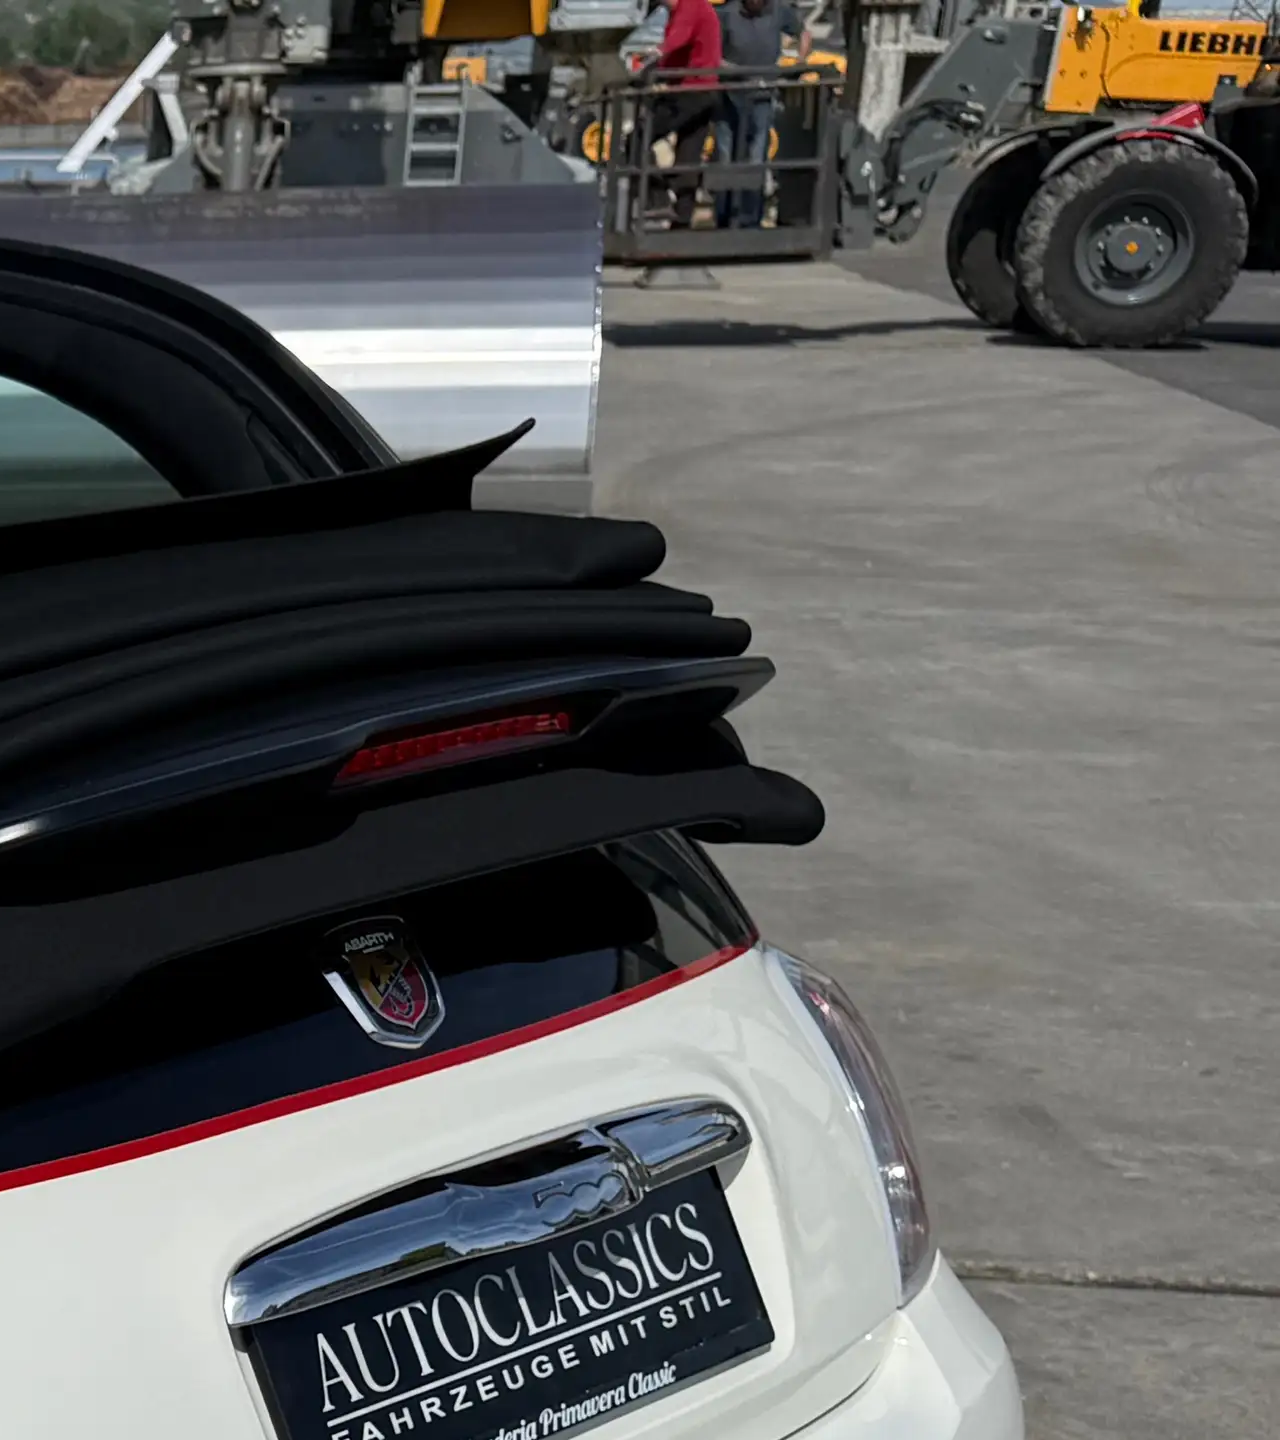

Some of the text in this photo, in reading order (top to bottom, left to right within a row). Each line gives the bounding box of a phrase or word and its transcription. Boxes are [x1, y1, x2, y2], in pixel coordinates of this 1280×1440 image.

[344, 931, 395, 952] ABARTH
[316, 1202, 715, 1413] AUTOCLASSICS
[589, 1317, 648, 1358] MIT
[661, 1291, 733, 1330] STIL
[539, 1383, 626, 1437] Primavera
[627, 1360, 678, 1400] Classic
